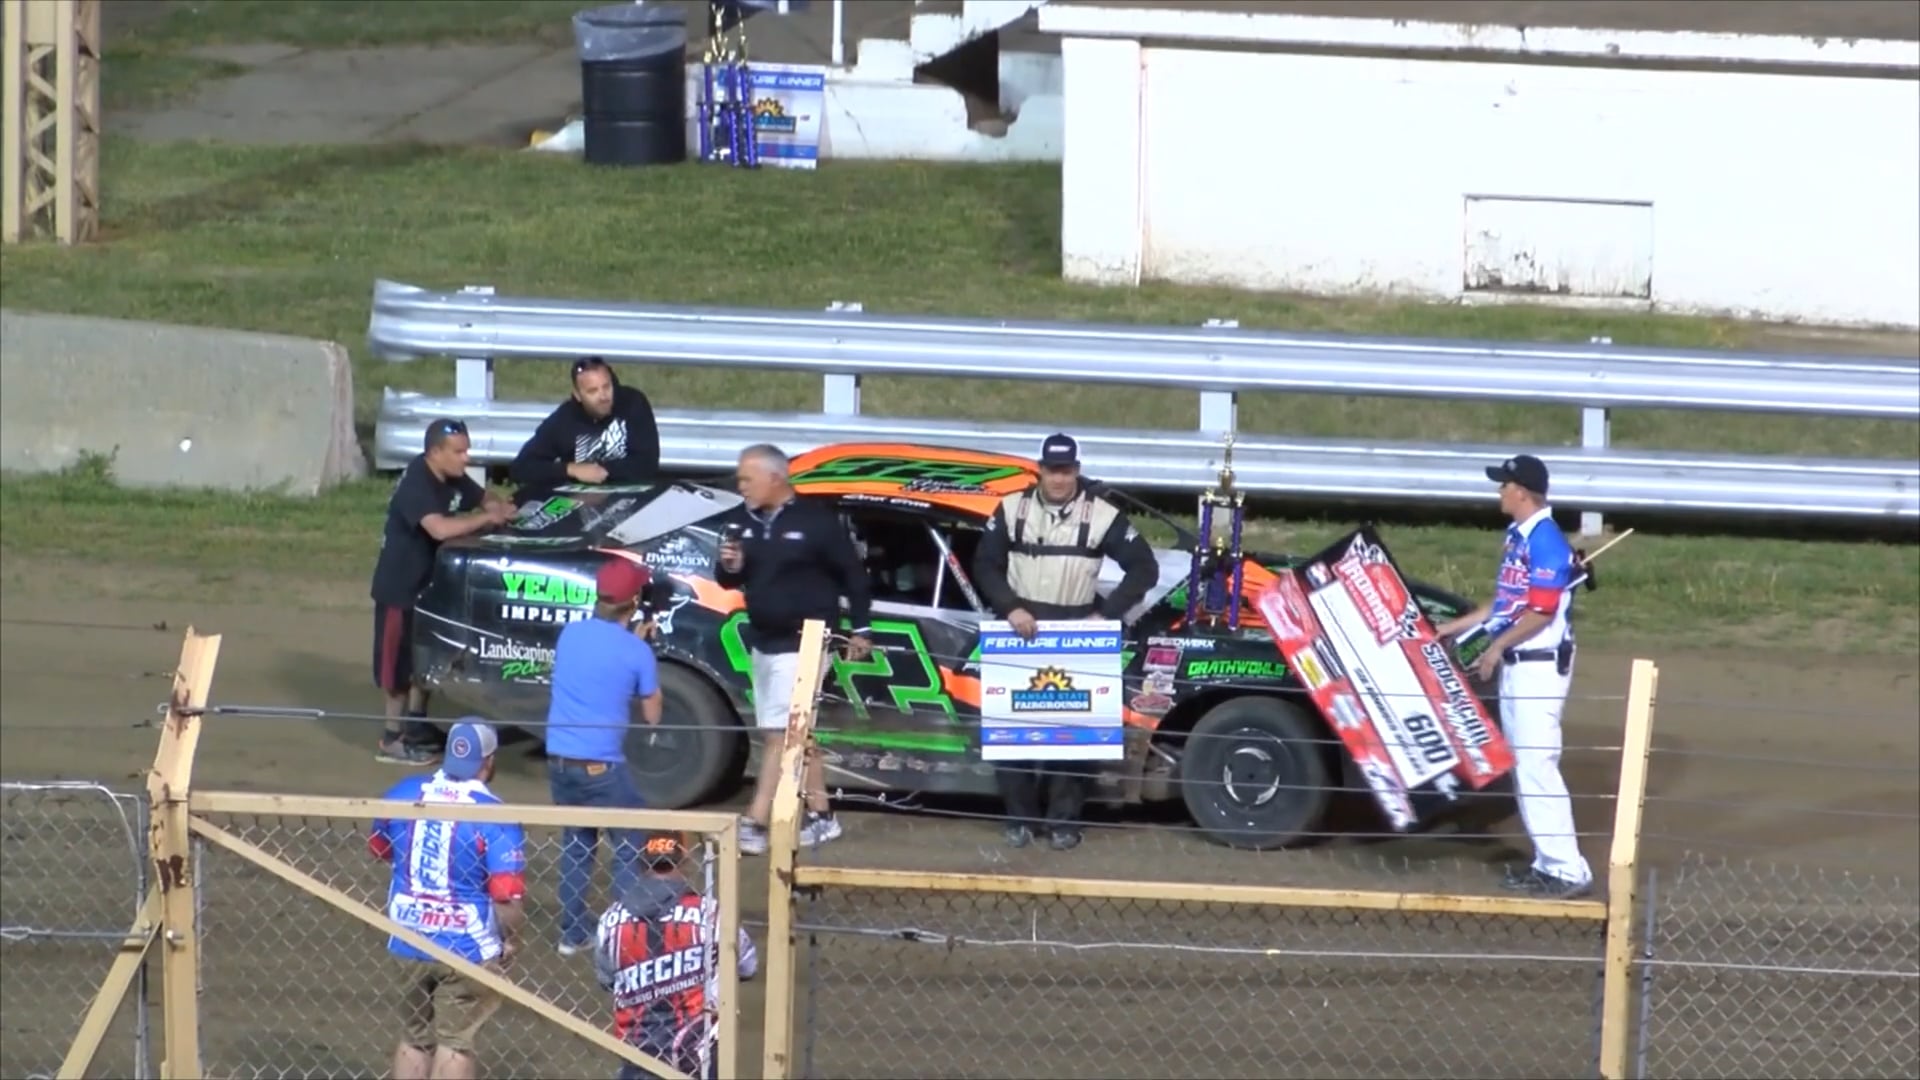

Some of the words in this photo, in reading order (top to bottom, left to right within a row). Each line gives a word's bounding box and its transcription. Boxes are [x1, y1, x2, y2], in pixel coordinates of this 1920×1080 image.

[1339, 555, 1402, 642] IRONMAN
[480, 637, 556, 669] Landscaping
[984, 636, 1059, 648] FEATURE
[1061, 636, 1118, 648] WINNER
[1420, 642, 1469, 704] STOCK
[985, 686, 1006, 696] 20
[1013, 691, 1055, 701] KANSAS
[1058, 691, 1089, 701] STATE
[1014, 700, 1090, 710] FAIRGROUNDS
[1403, 713, 1454, 765] 600
[613, 945, 710, 994] PRECIS
